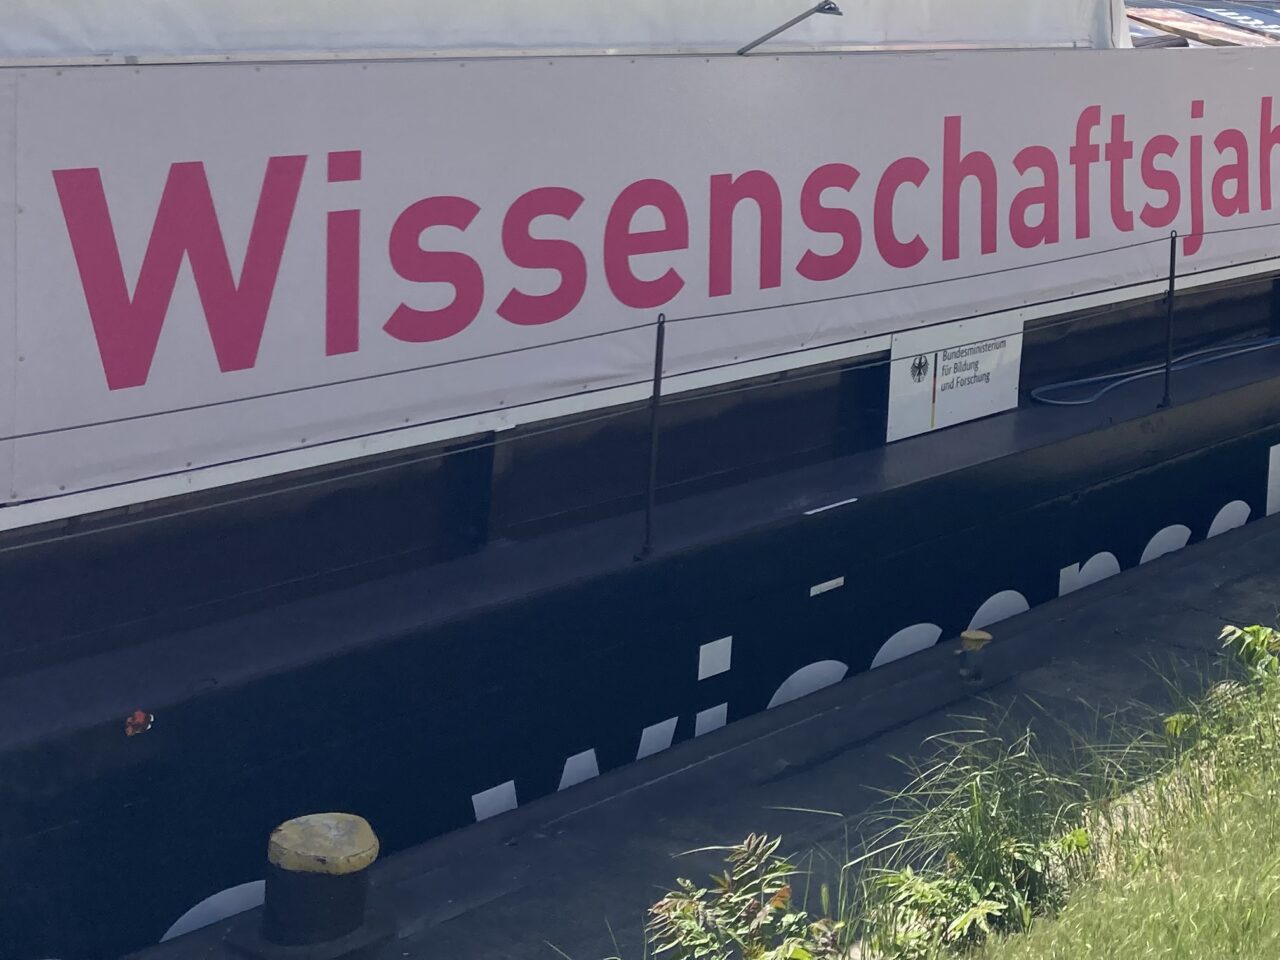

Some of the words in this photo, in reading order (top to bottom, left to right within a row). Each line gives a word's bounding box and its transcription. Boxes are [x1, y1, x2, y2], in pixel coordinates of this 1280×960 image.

[942, 339, 1007, 361] Bundesministerium
[941, 364, 952, 377] für
[953, 360, 979, 374] Bildung
[940, 377, 955, 392] und
[956, 371, 991, 388] Forschung
